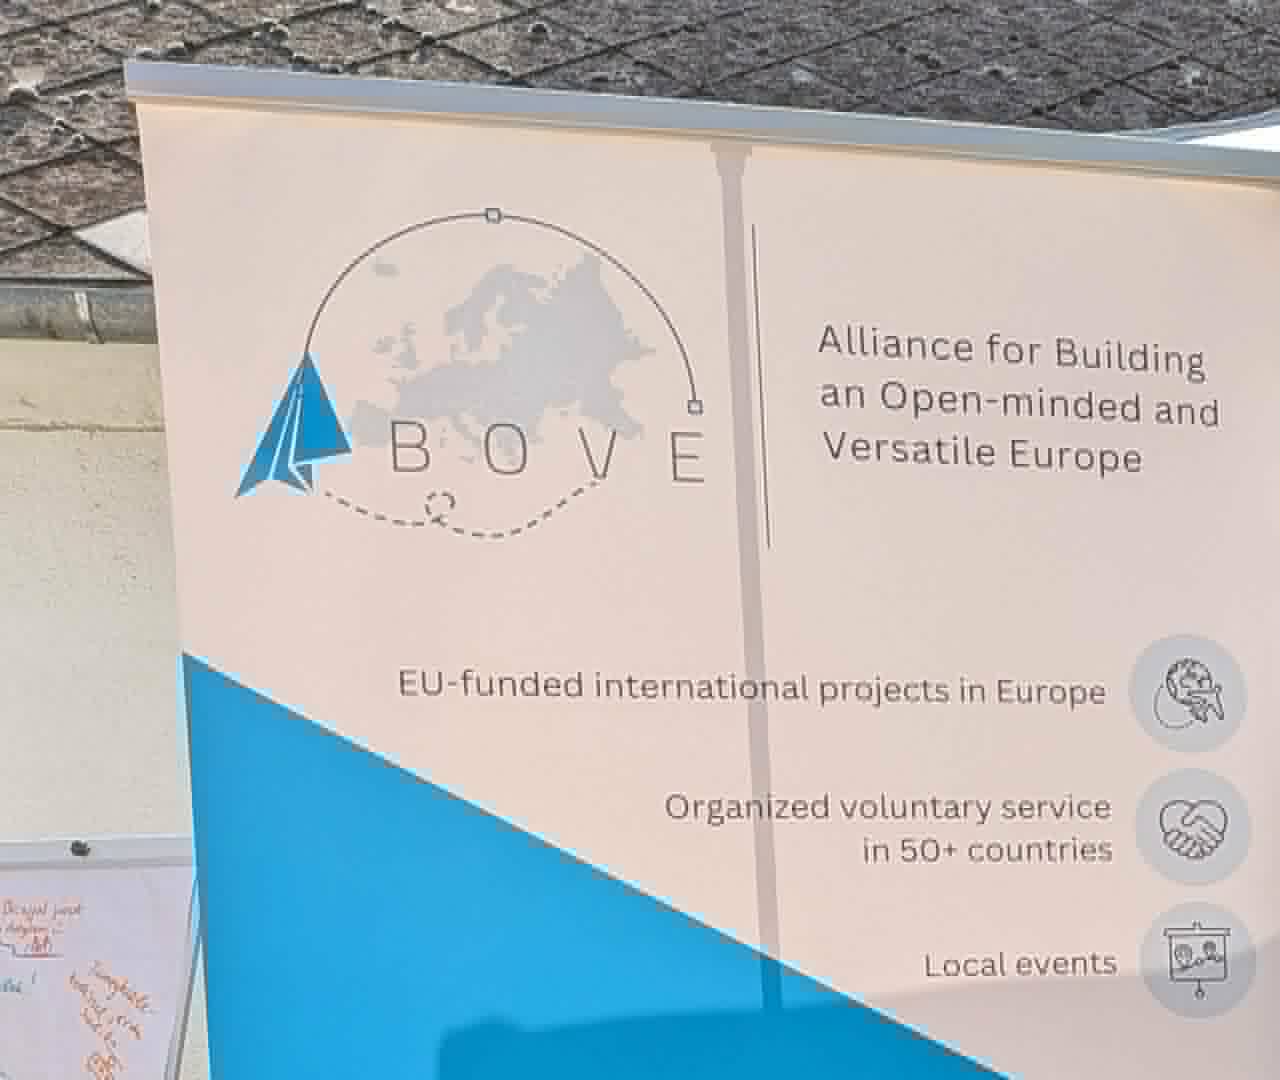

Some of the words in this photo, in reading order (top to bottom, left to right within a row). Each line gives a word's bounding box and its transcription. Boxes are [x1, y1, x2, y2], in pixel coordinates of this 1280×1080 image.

[818, 323, 974, 363] Alliance
[988, 331, 1040, 366] for
[1055, 336, 1207, 385] Building
[820, 382, 864, 409] an
[880, 381, 1142, 423] Open-minded
[1155, 392, 1221, 428] and
[822, 430, 995, 467] Versatile
[1009, 439, 1144, 476] Europe
[398, 668, 584, 700] EU-funded
[594, 671, 809, 703] international
[819, 673, 950, 707] projects
[959, 681, 988, 706] in
[996, 681, 1107, 711] Europe
[665, 790, 829, 826] Organized
[838, 793, 992, 825] voluntary
[1000, 794, 1112, 821] service
[862, 837, 893, 864] in
[901, 838, 959, 864] 50+
[966, 838, 1113, 866] countries
[924, 951, 1006, 979] Local
[1015, 951, 1118, 979] events
